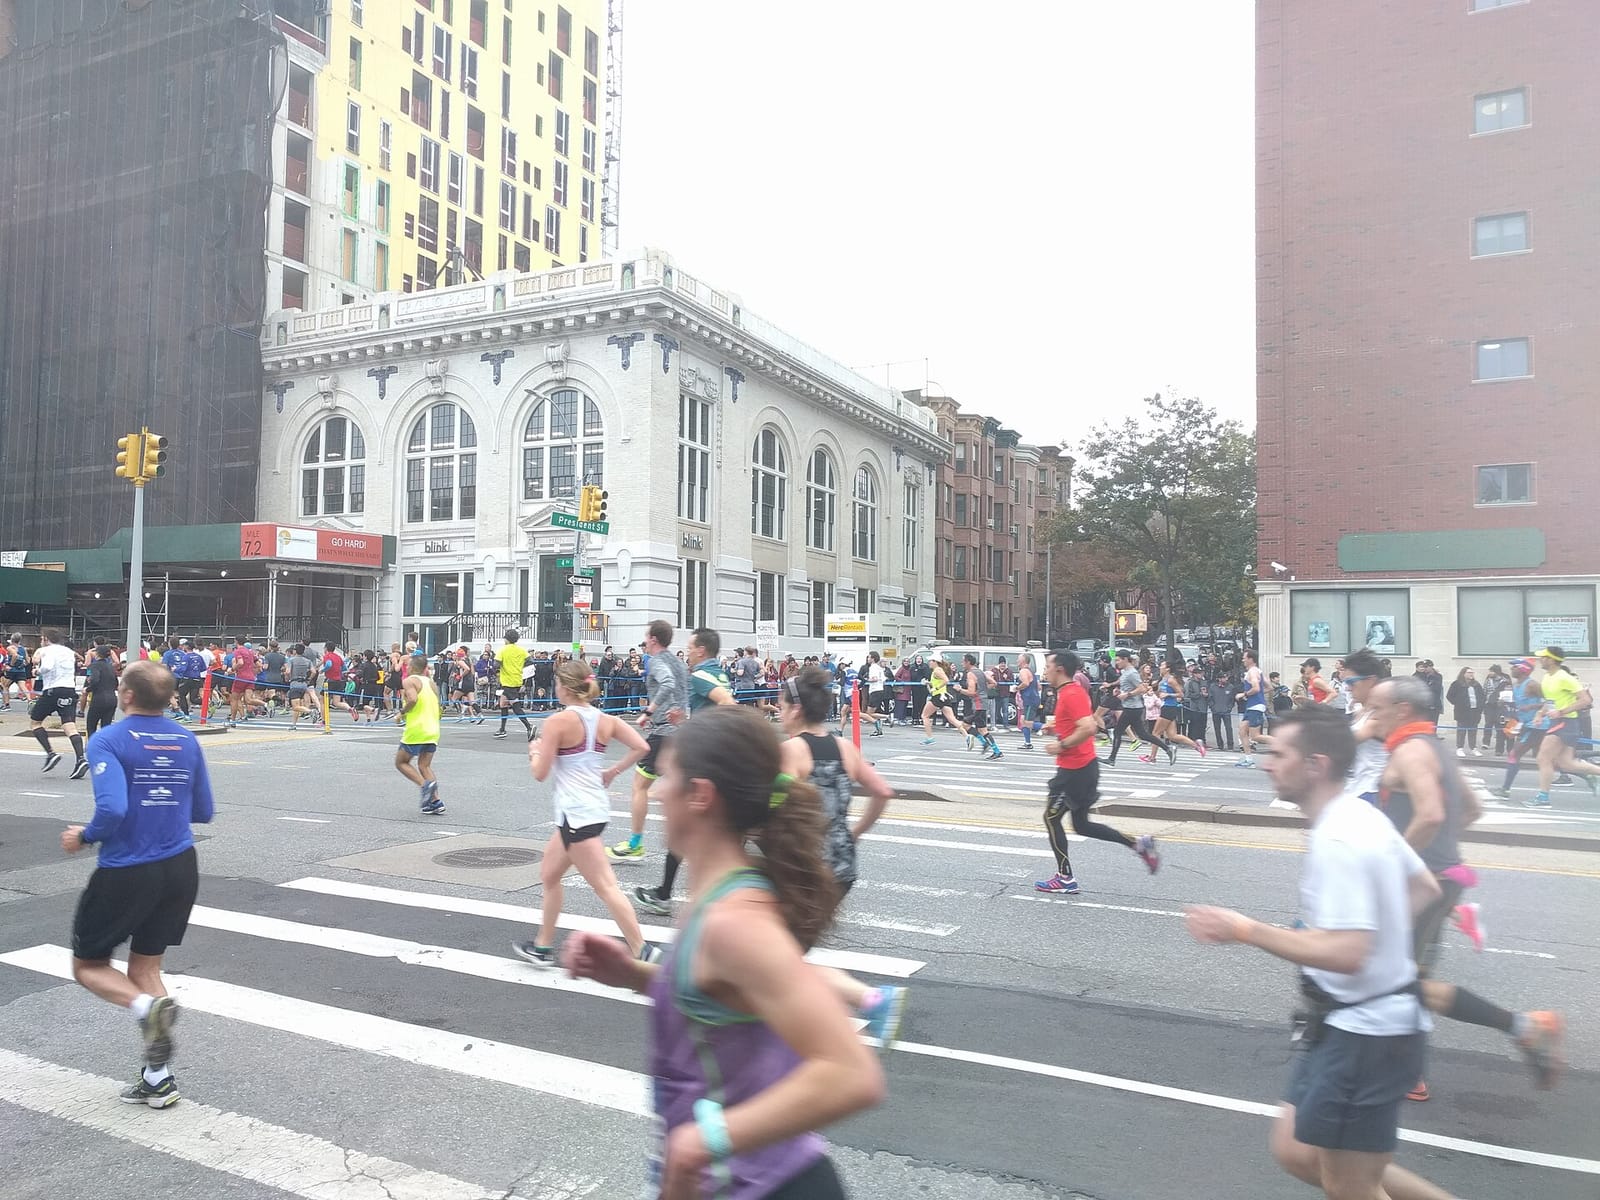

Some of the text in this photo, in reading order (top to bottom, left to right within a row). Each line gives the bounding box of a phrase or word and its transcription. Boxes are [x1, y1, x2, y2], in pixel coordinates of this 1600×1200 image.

[597, 522, 604, 532] St
[331, 538, 367, 549] GO HARD!
[424, 540, 449, 553] blink
[682, 532, 703, 550] blink
[244, 541, 262, 556] 7.2
[2, 552, 24, 561] RETAIL
